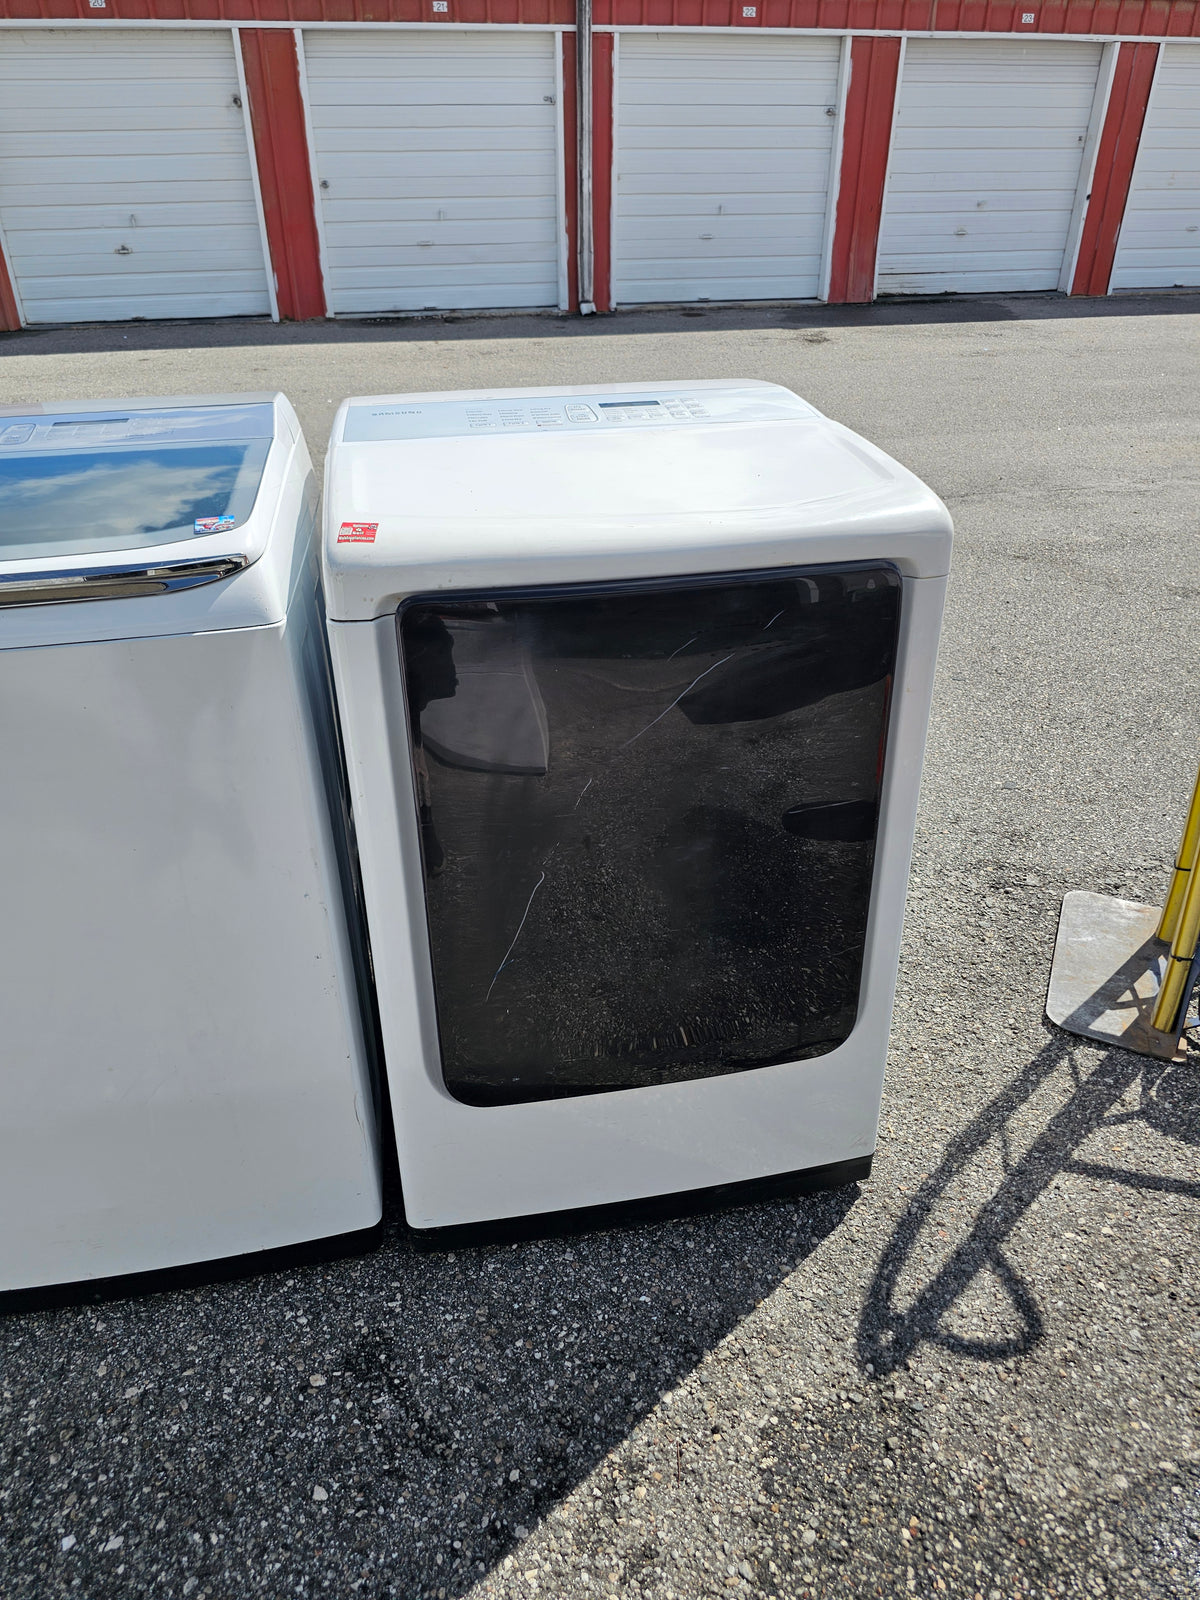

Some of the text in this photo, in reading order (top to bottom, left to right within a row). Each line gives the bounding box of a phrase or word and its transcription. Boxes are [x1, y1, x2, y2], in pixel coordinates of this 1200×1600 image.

[436, 2, 445, 11] 21
[744, 7, 754, 16] 22
[1023, 14, 1033, 23] 23
